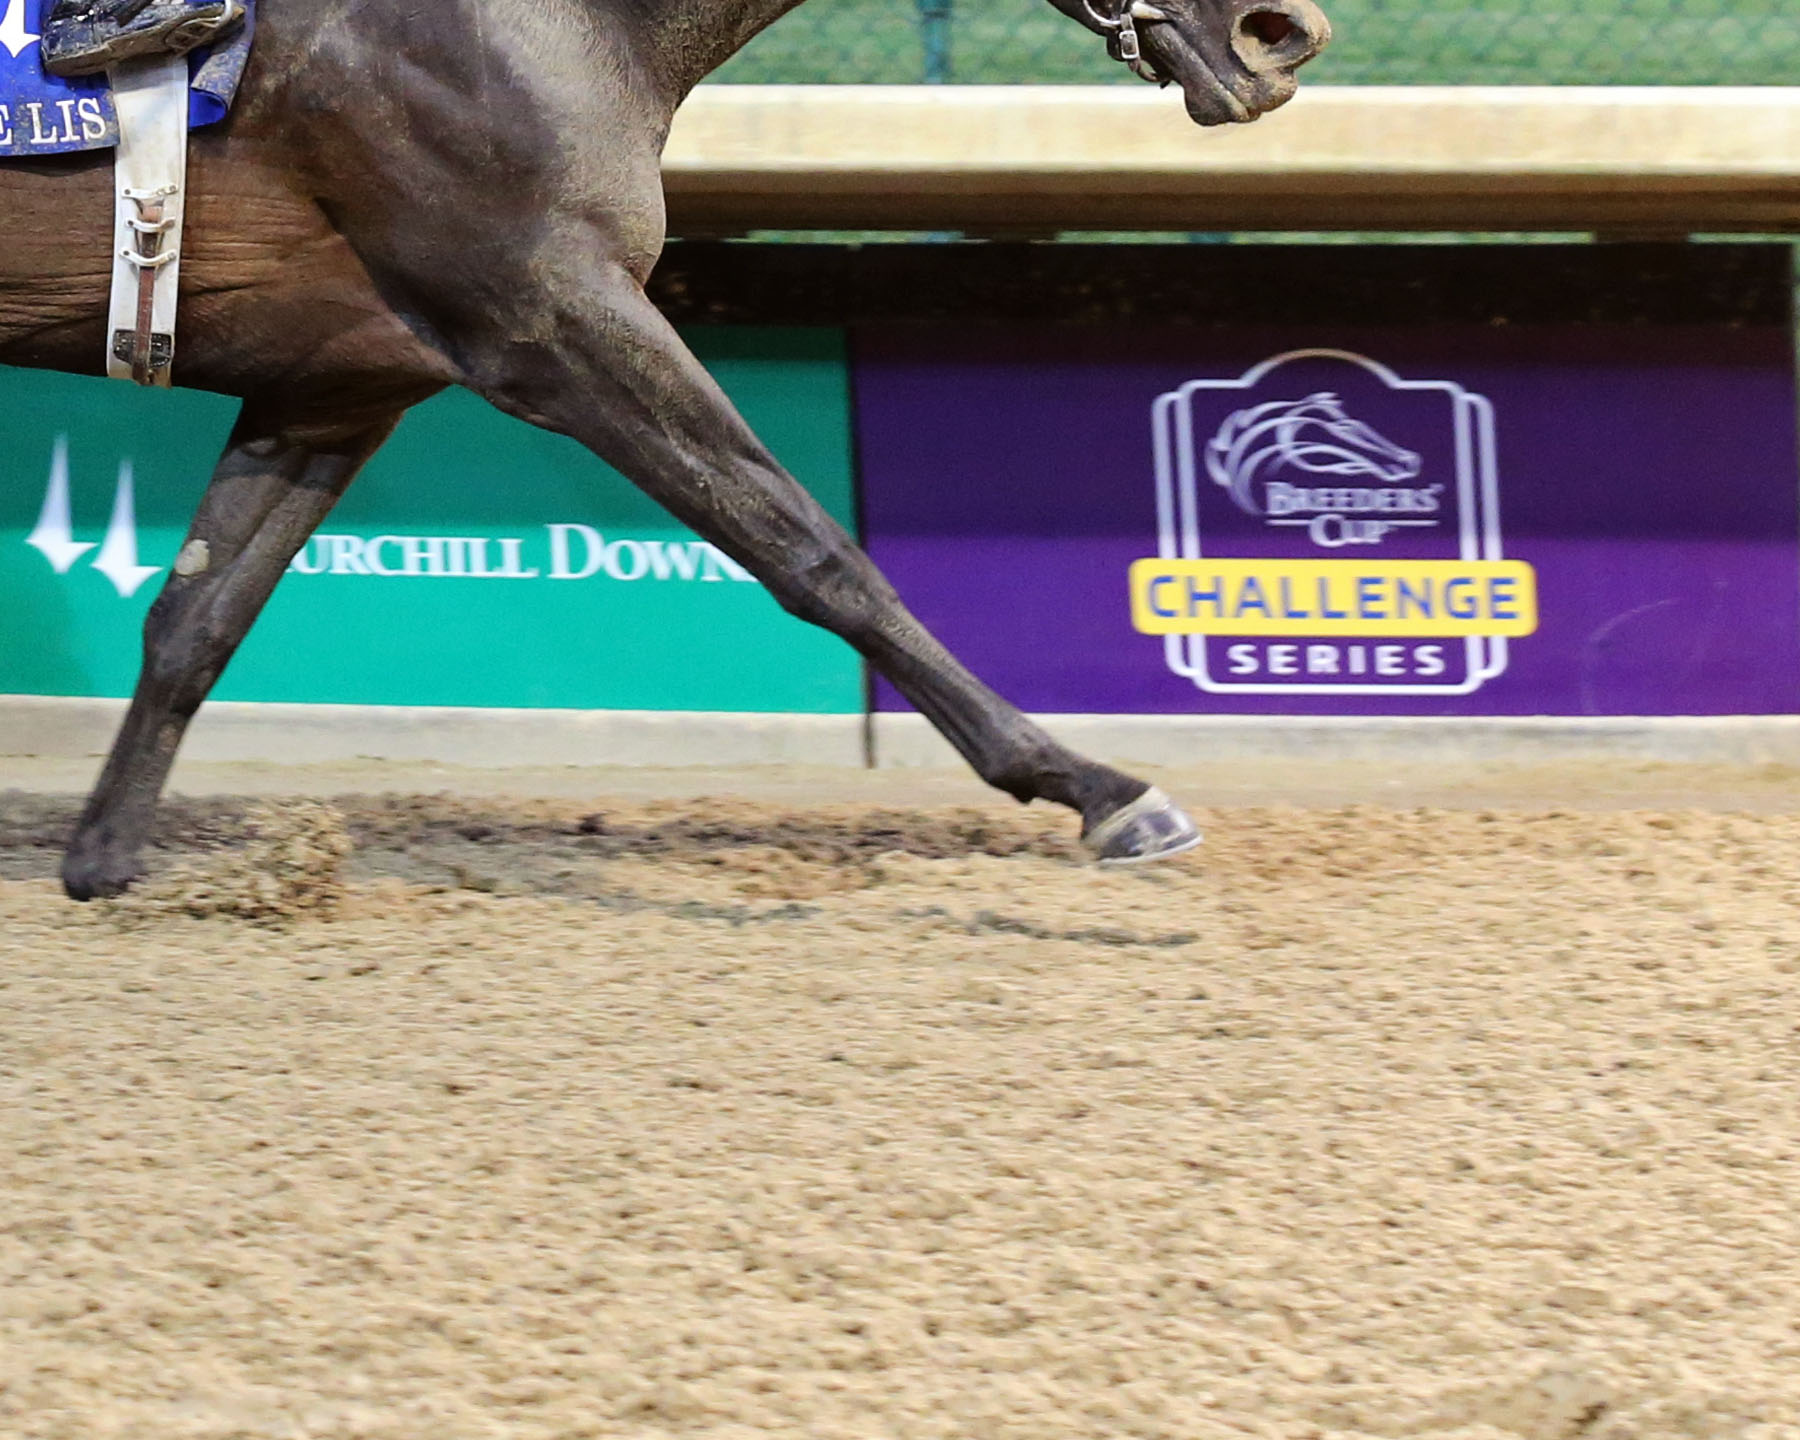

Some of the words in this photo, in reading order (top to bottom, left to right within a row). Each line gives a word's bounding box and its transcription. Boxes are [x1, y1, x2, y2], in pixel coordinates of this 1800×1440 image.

[27, 95, 107, 146] LIS
[286, 534, 540, 578] URCHILL
[545, 523, 760, 583] DOWN
[1146, 574, 1521, 621] CHALLENGE
[1227, 643, 1447, 676] SERIES
